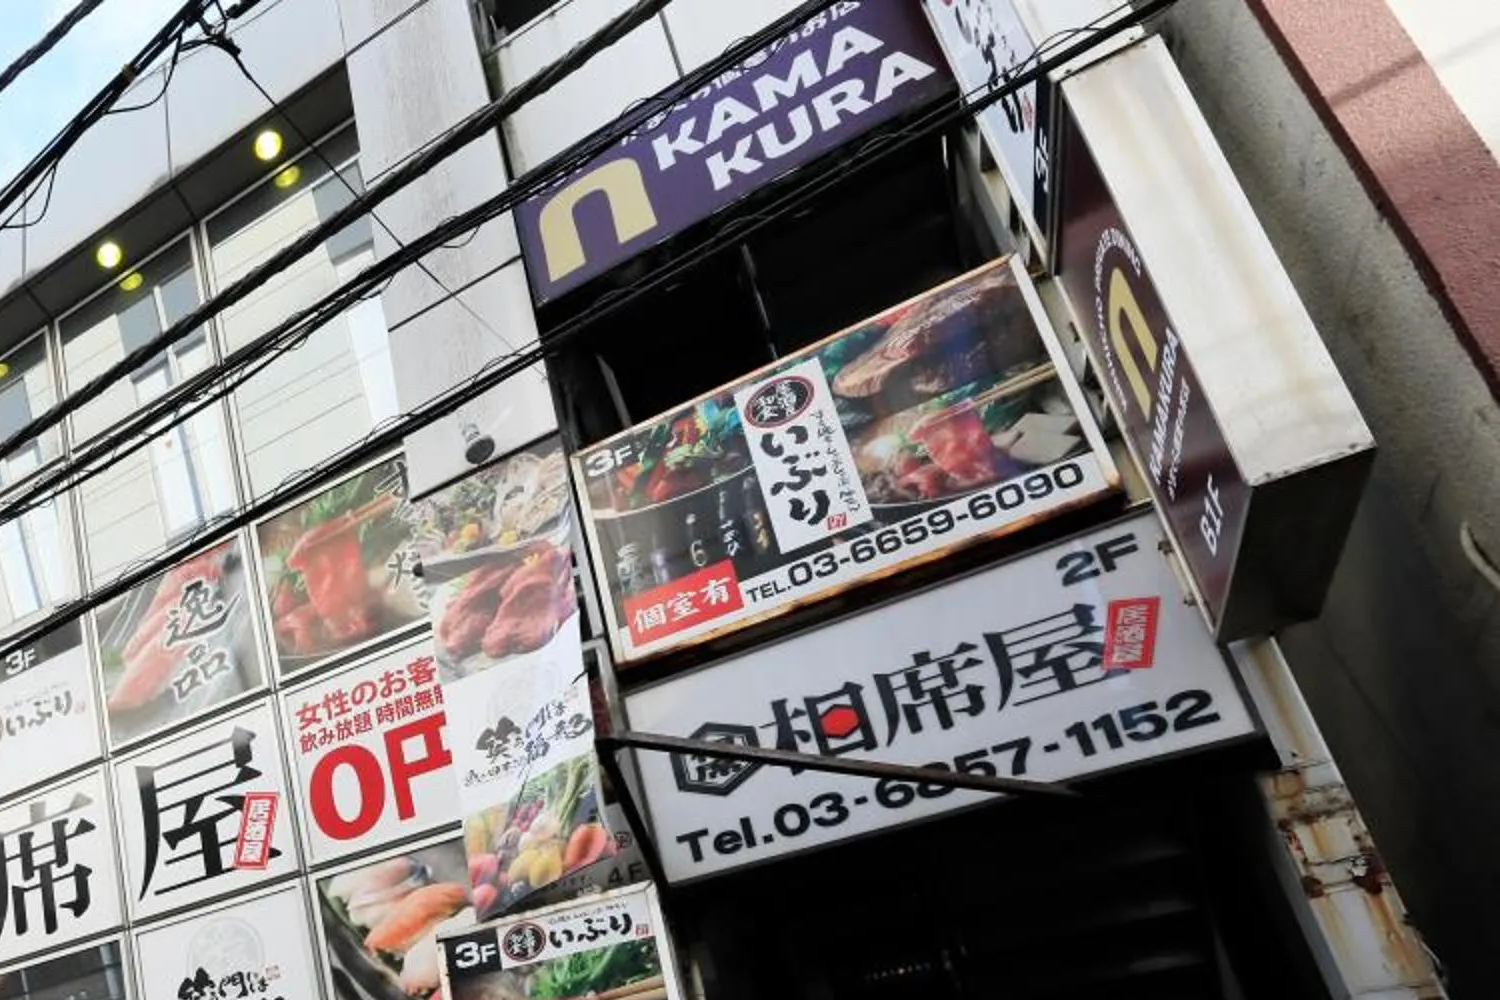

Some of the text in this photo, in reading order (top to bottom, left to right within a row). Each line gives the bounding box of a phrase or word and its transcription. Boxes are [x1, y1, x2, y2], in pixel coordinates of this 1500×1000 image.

[652, 25, 884, 171] KAMA
[705, 51, 936, 191] KURA
[585, 444, 631, 477] 3F
[759, 425, 831, 526] いぶり
[746, 461, 1084, 603] TEL.03-6659-6090
[1200, 472, 1226, 556] B1F
[1055, 533, 1141, 586] 2F
[634, 577, 732, 633] 個室有
[6, 648, 36, 675] 3F
[165, 578, 243, 702] 逸品
[6, 690, 73, 736] いぶり
[295, 656, 438, 730] 女性のお客
[759, 603, 1134, 775] 相席屋
[299, 709, 373, 754] 飲み放題
[454, 941, 497, 969] 3F
[548, 912, 632, 948] いぶり
